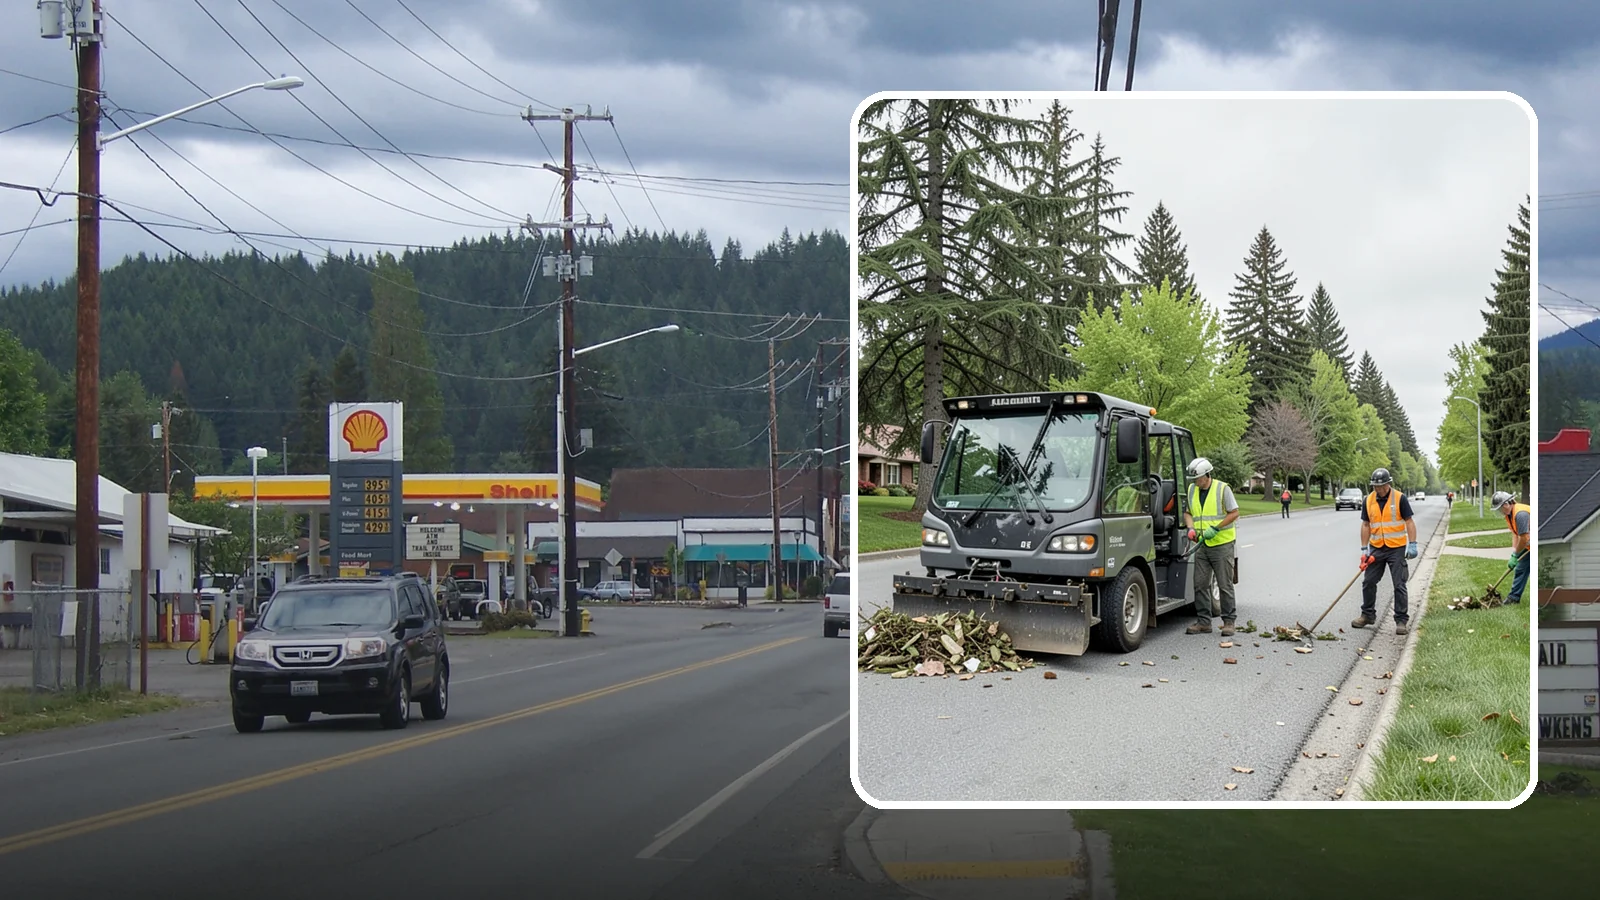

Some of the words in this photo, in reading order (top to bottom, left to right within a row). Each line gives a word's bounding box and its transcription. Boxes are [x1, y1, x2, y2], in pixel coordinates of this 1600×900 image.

[366, 480, 383, 490] 395
[489, 484, 547, 499] Shell
[366, 494, 383, 504] 405
[366, 508, 383, 518] 415
[366, 522, 383, 532] 429
[1538, 642, 1567, 666] AID
